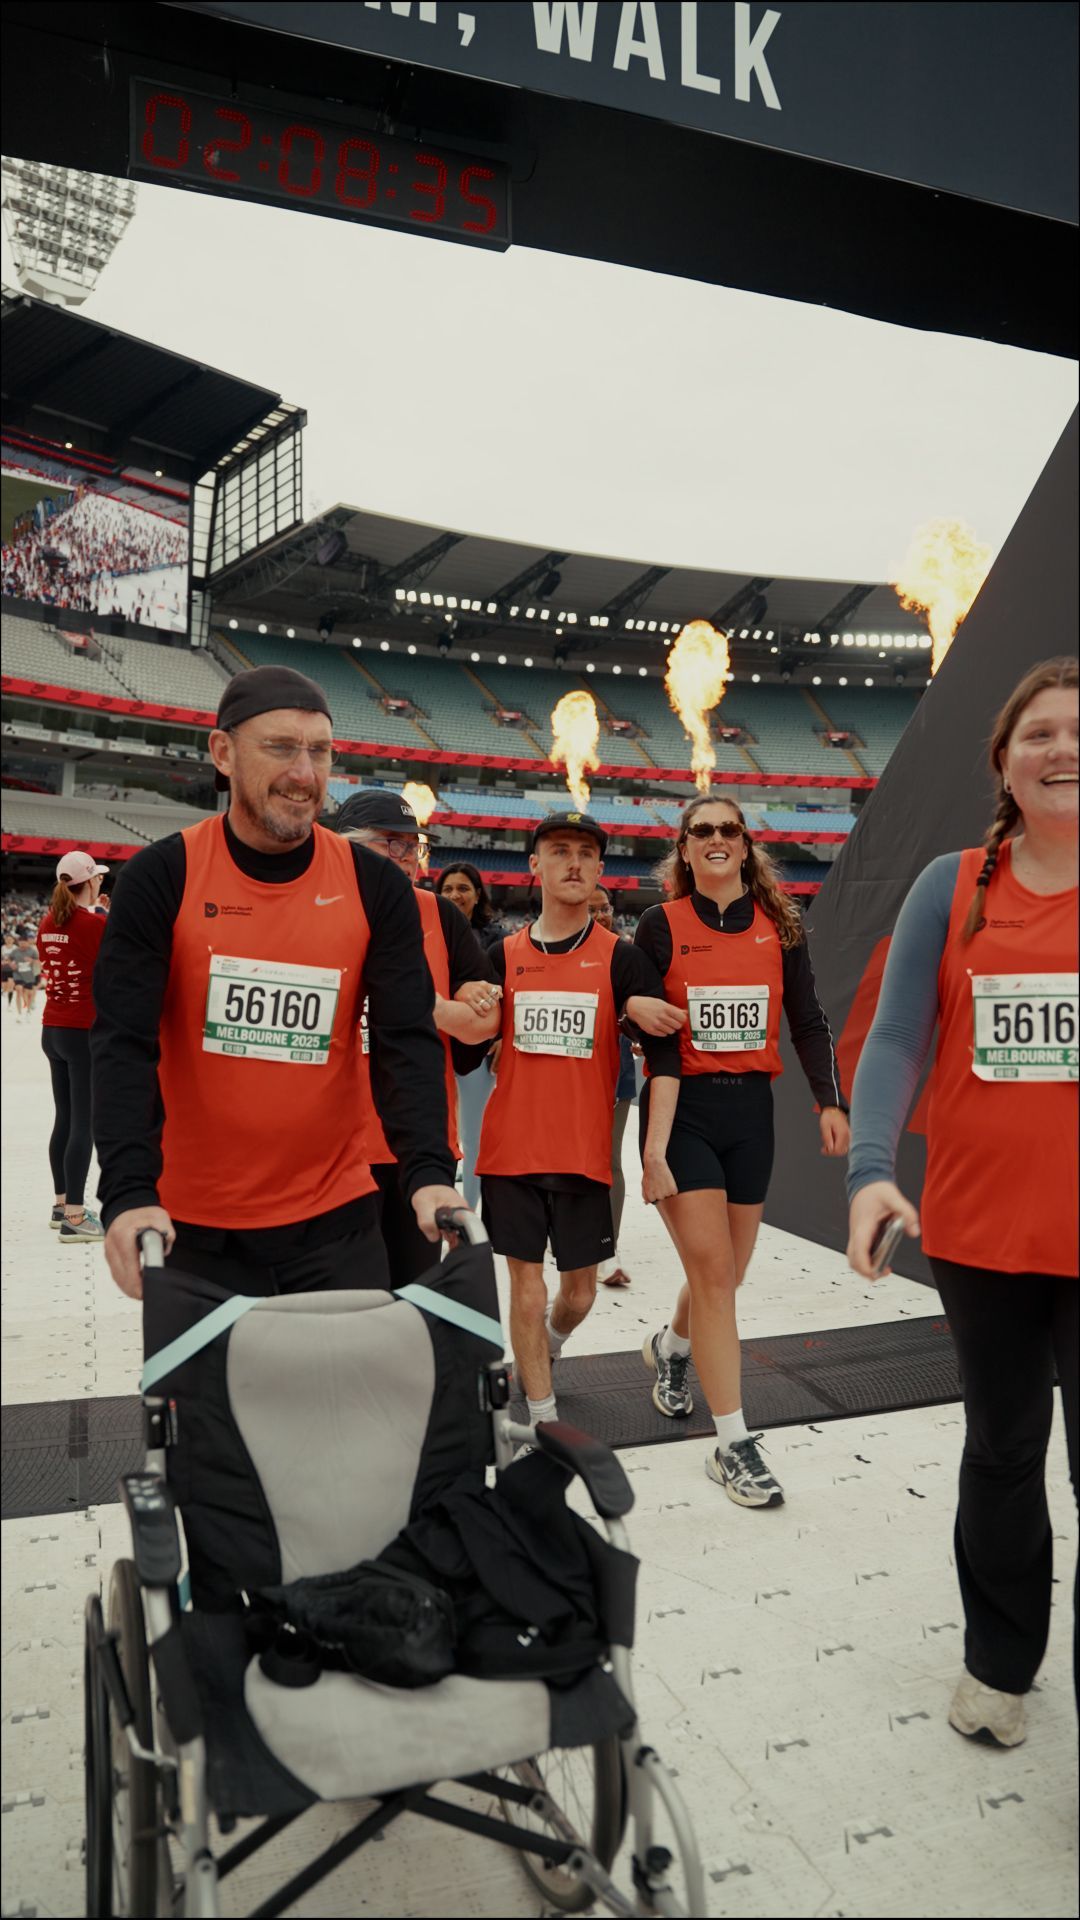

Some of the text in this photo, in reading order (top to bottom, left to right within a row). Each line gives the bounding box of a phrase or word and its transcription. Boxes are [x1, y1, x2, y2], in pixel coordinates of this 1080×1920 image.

[533, 2, 782, 111] WALK
[143, 94, 497, 234] 02:08:35
[225, 984, 321, 1031] 56160
[700, 1002, 759, 1029] 56163
[523, 1008, 586, 1035] 56159
[993, 1002, 1079, 1044] 5616
[216, 1026, 321, 1048] MELBOURNE 2025
[519, 1034, 587, 1047] MELBOURNE 2025
[697, 1031, 761, 1041] MELBOURNE 2025
[986, 1049, 1064, 1064] MELBOURNE
[712, 1077, 743, 1085] MOVE
